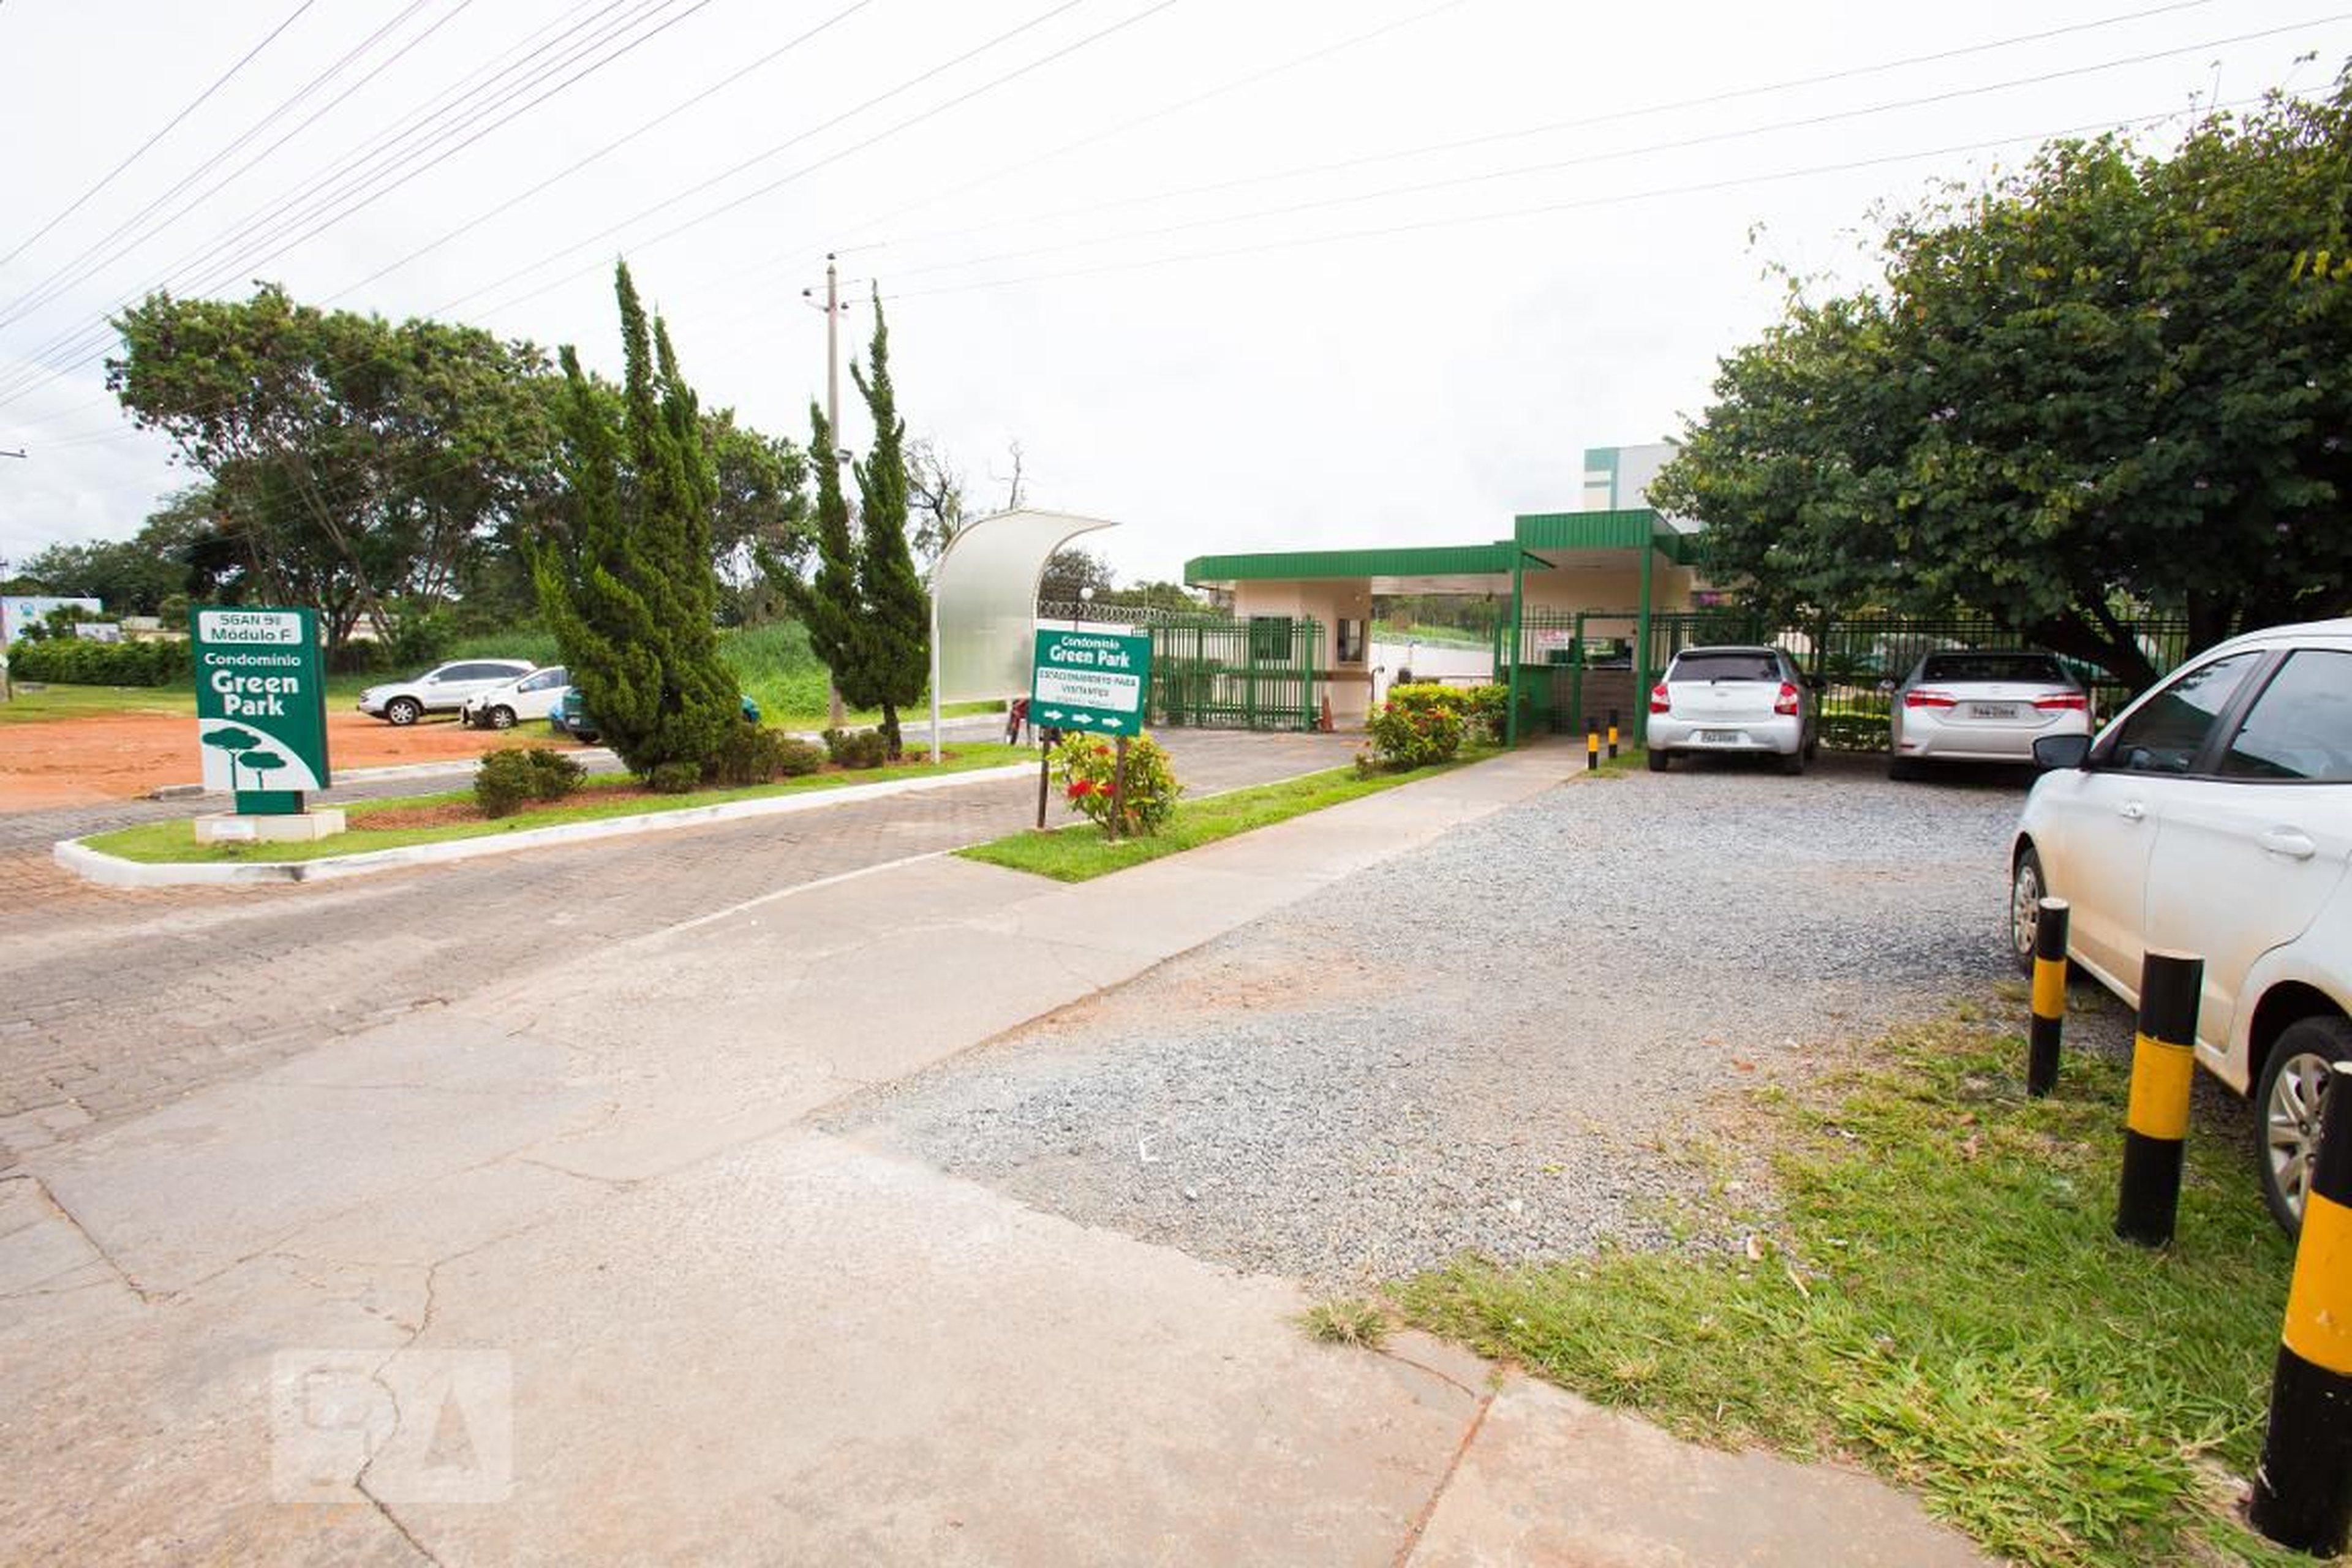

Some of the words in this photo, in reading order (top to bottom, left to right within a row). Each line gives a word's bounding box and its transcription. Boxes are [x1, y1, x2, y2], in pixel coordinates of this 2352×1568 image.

[220, 614, 260, 625] SGAN
[281, 628, 292, 641] F
[1050, 645, 1093, 664] Green
[1098, 649, 1131, 668] Park
[211, 669, 299, 693] Green
[224, 694, 285, 715] Park
